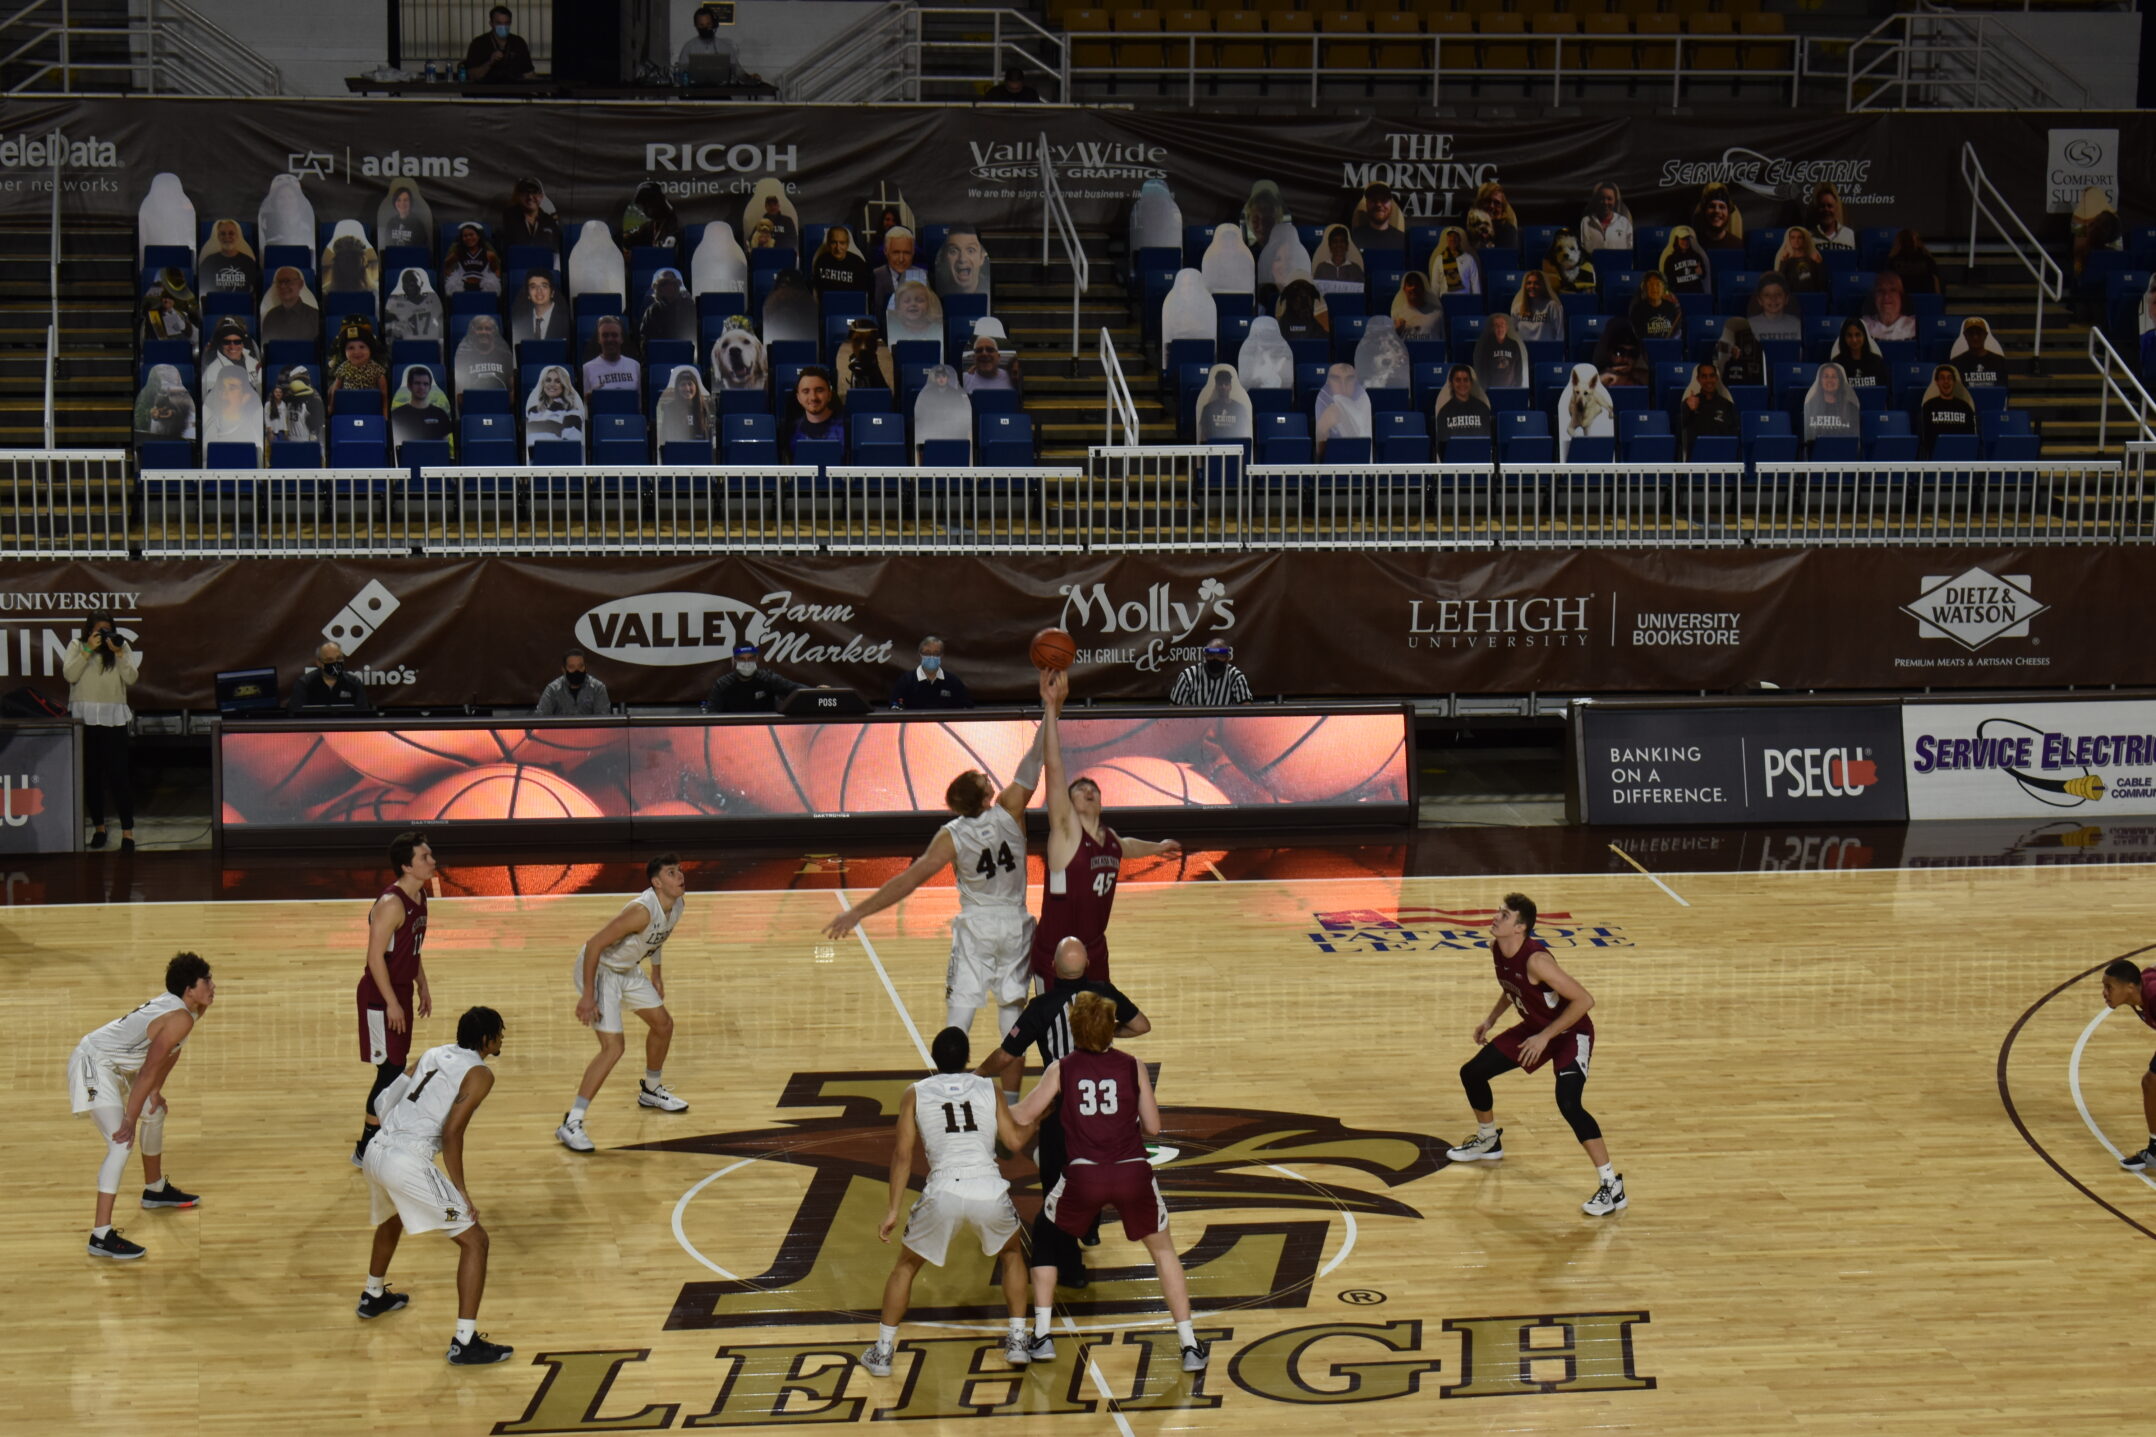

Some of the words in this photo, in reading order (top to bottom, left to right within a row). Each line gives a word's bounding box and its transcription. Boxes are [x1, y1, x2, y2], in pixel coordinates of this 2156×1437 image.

[0, 134, 117, 168] eleData
[969, 141, 1168, 168] ValleyWide
[1385, 133, 1453, 161] THE
[362, 150, 470, 178] adams
[646, 143, 798, 173] RICOH
[978, 168, 1039, 179] SIGNS
[1067, 168, 1168, 179] GRAPHICS
[1341, 162, 1500, 190] MORNING
[2051, 169, 2114, 186] COMFORT
[0, 179, 22, 192] er
[31, 177, 119, 192] neworks
[646, 177, 725, 198] magine.
[730, 178, 801, 198] chae.
[1800, 194, 1894, 206] Cnications
[2051, 188, 2114, 204] SUIS
[215, 273, 246, 282] LEHIGH
[819, 267, 853, 284] LEHIGH
[469, 363, 503, 374] LEHIGH
[1964, 371, 1997, 382] LEHIGH
[598, 372, 634, 385] LEHIGH
[1849, 376, 1876, 387] EHIGH
[1446, 415, 1481, 427] LEHIGH
[1931, 412, 1966, 423] LEHIGH
[0, 592, 141, 611] UNIVERSITY
[1945, 586, 1998, 605] DIETZ
[2001, 588, 2016, 604] &
[588, 611, 756, 648] VALLEY
[760, 590, 855, 629] Farm
[1059, 582, 1237, 644] Molly's
[1408, 597, 1590, 634] LEHIGH
[1636, 612, 1741, 630] UNIVERSITY
[1932, 605, 2016, 623] WATSON
[1408, 634, 1589, 649] UNIVERSITY
[1632, 629, 1740, 646] BOOKSTORE
[760, 631, 894, 664] Market
[1095, 647, 1136, 664] GRILLE
[1894, 657, 1935, 667] PREMIUM
[1937, 657, 1965, 666] MEATS
[1976, 657, 2013, 666] ARTISAN
[2014, 656, 2050, 666] CHEESES
[304, 664, 418, 686] mino's
[817, 697, 838, 709] POSS
[1610, 746, 1702, 763] BANKING
[1914, 734, 2034, 773] SERVICE
[1611, 768, 1642, 784] ON
[1647, 768, 1661, 783] A
[1763, 746, 1865, 799] PSECU
[2116, 777, 2152, 787] CABLE
[1612, 787, 1728, 804] DIFFERENCE.
[975, 840, 1017, 880] 44
[1092, 871, 1117, 897] 45
[1307, 925, 1625, 943] PATROT
[407, 1068, 438, 1103] 1
[1077, 1078, 1119, 1116] 33
[941, 1100, 978, 1133] 11
[489, 1310, 1658, 1435] LEHIGH
